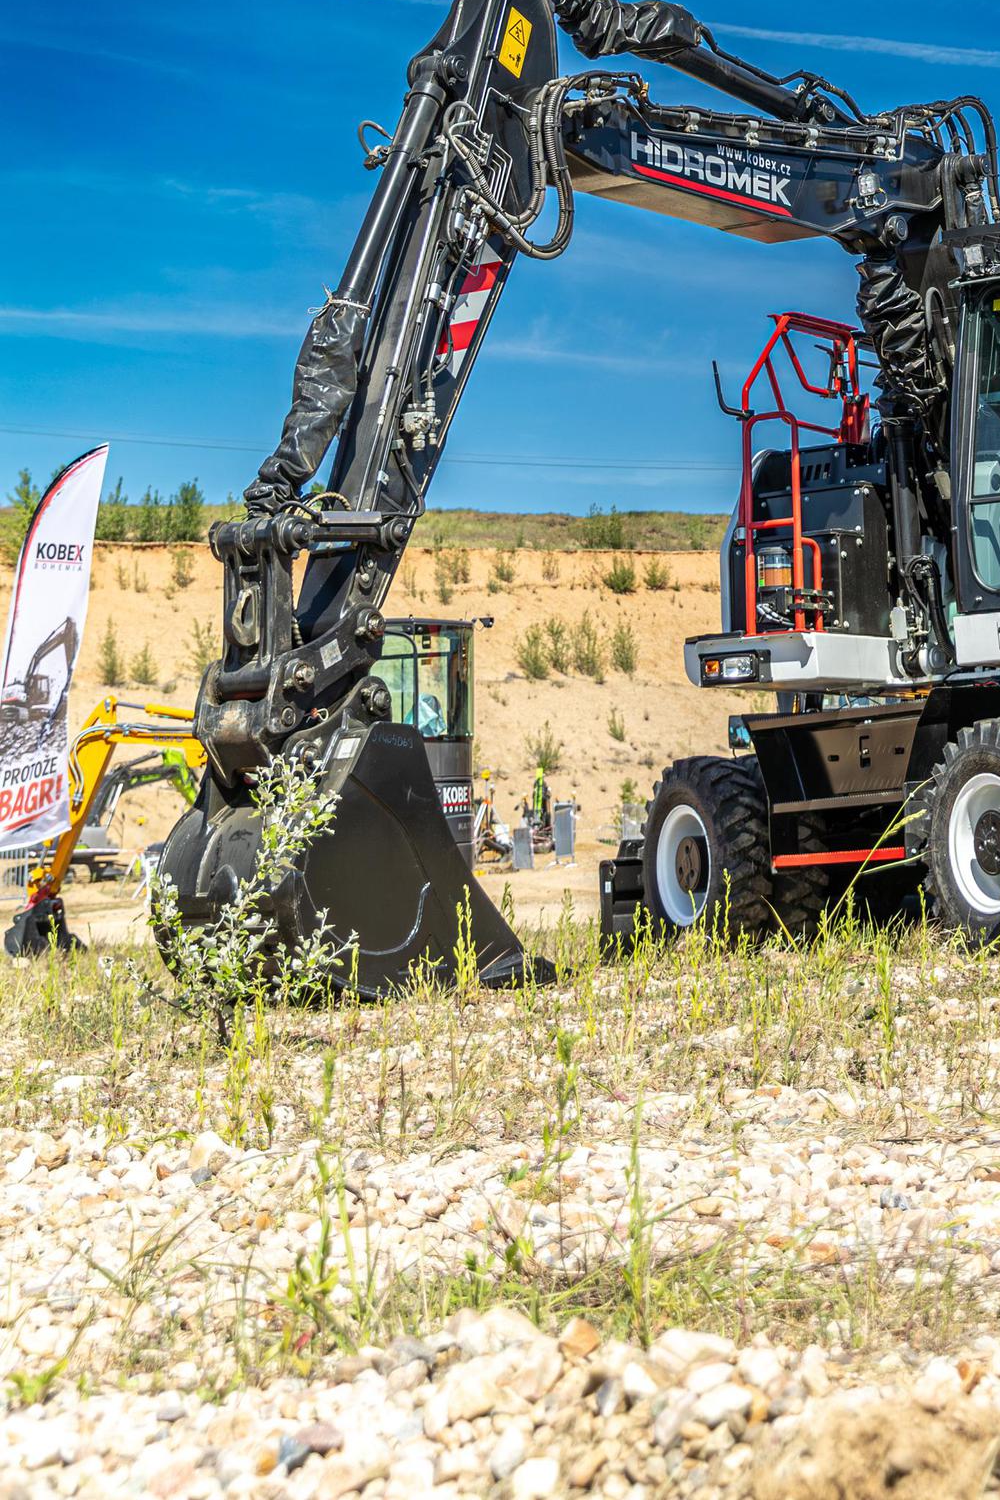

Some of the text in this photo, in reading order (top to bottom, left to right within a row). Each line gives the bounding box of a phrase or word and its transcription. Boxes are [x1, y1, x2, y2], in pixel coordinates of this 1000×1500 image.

[716, 143, 791, 177] www.kobex.cz
[34, 562, 83, 572] BOHEMIA
[36, 542, 85, 562] KOBEX
[2, 754, 58, 788] PROTOŽE
[0, 773, 63, 823] BAGR!
